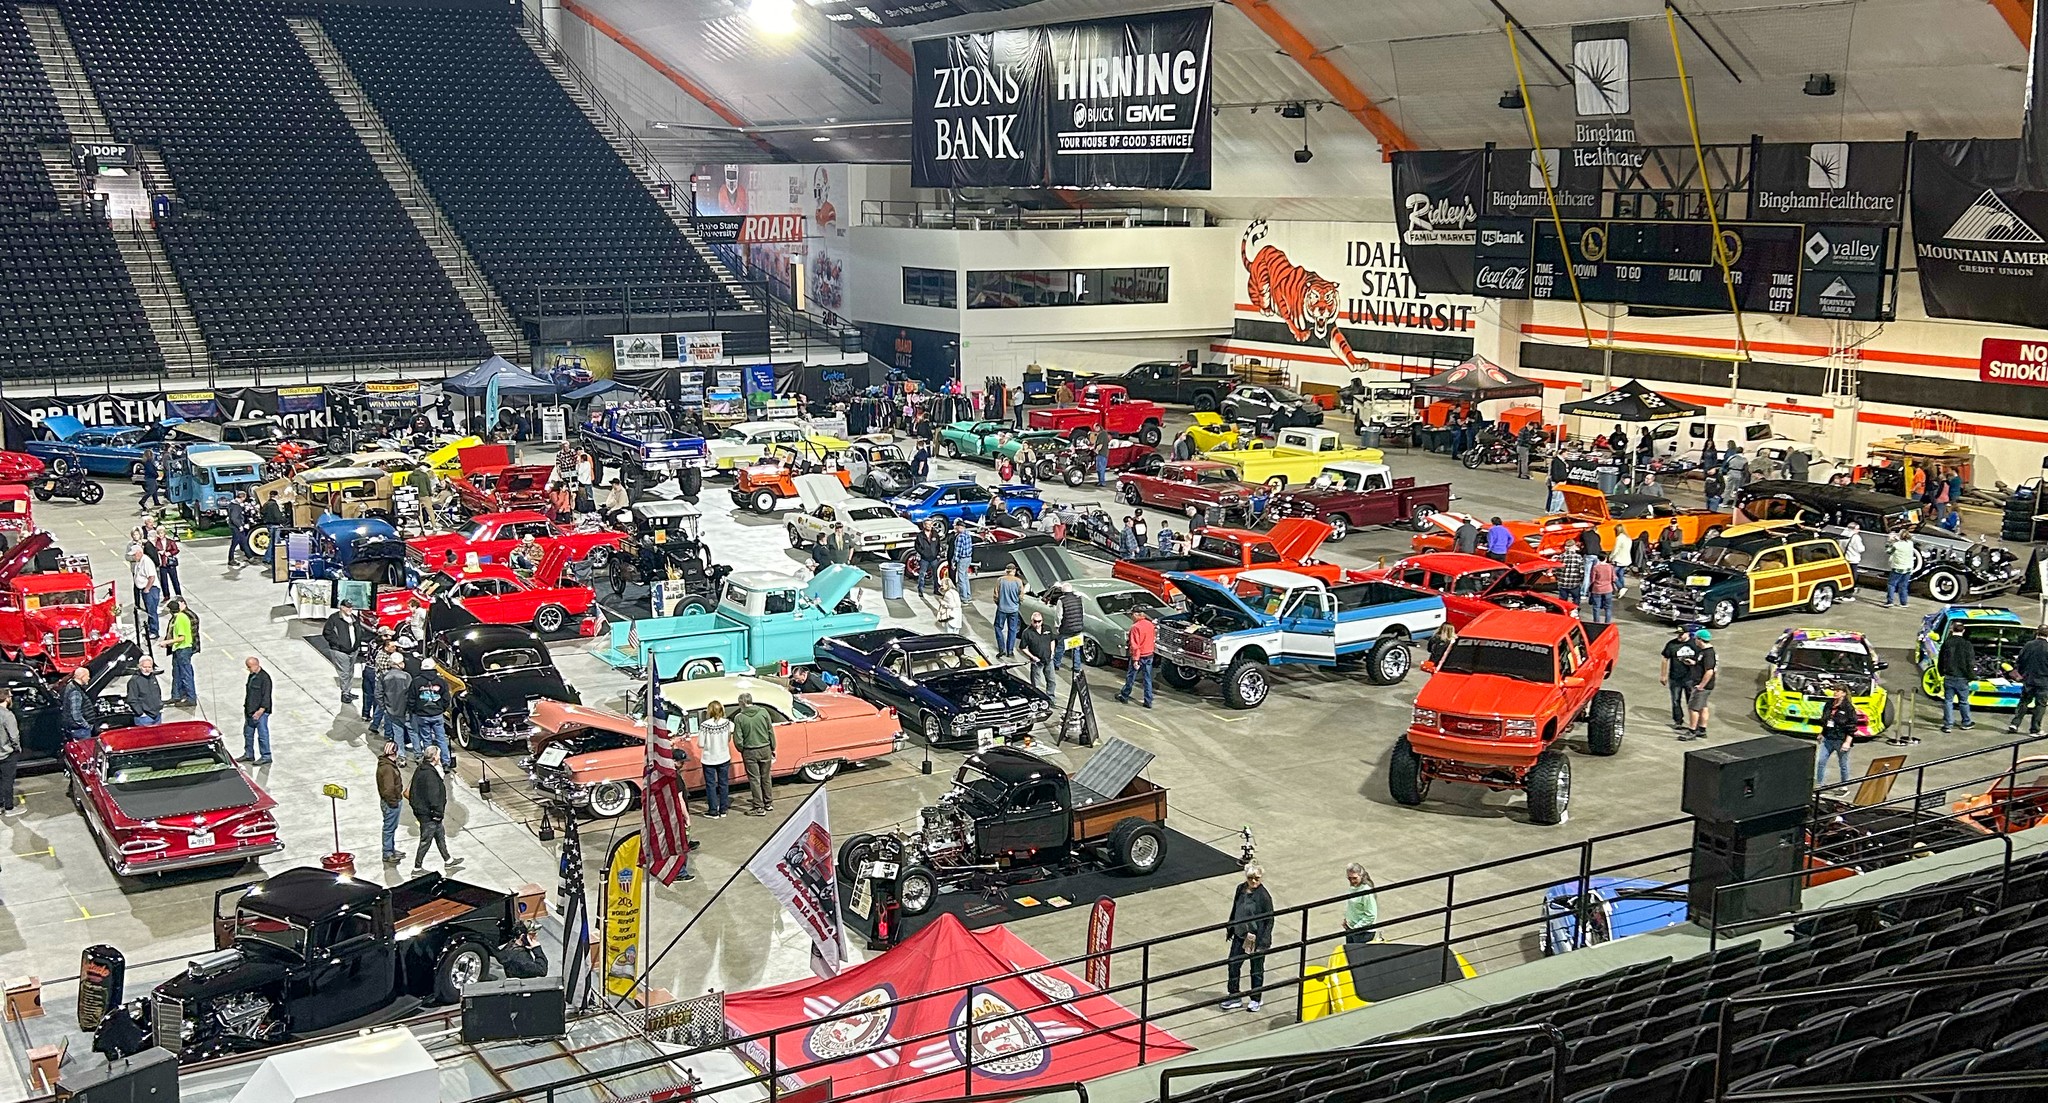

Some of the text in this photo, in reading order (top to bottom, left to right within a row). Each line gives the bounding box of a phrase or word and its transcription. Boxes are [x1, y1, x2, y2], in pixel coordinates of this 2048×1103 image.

[1057, 50, 1196, 101] HIRNING
[934, 62, 1020, 108] ZIONS
[1087, 104, 1176, 123] BUICK GMC
[1576, 122, 1636, 146] Bingham
[1060, 136, 1191, 148] YOUR HOUSE OF GOOD SERVICE!
[92, 146, 126, 156] DOPP
[1573, 148, 1643, 168] Healthcare
[1759, 191, 1894, 212] BinghamHealthcare
[1406, 193, 1478, 231] Ridley's
[745, 216, 800, 240] ROAR!
[1410, 233, 1476, 242] FAMILY MARKET
[1832, 240, 1880, 260] valley
[1918, 243, 1998, 262] MOUNTAIN
[1536, 264, 1553, 274] TIME
[1573, 264, 1597, 277] DOWN
[1616, 266, 1641, 279] TO GO
[1669, 269, 1702, 282] BALL ON
[1959, 264, 2033, 276] CREDIT UNION
[1362, 270, 1426, 300] STAT
[1534, 275, 1553, 286] OUTS
[1772, 274, 1793, 285] TIME
[1534, 287, 1552, 297] LEFT
[1769, 287, 1793, 299] OUTS
[1769, 301, 1791, 312] LEFT
[1819, 298, 1856, 306] MOUNTAIN
[1348, 298, 1477, 332] UNIVERSIT
[1821, 305, 1852, 313] AMERICA
[895, 339, 912, 353] IDAHO
[2020, 344, 2047, 363] NO
[895, 353, 912, 368] STATE
[1474, 640, 1549, 654] VENOM POWER
[1457, 722, 1483, 731] GMC
